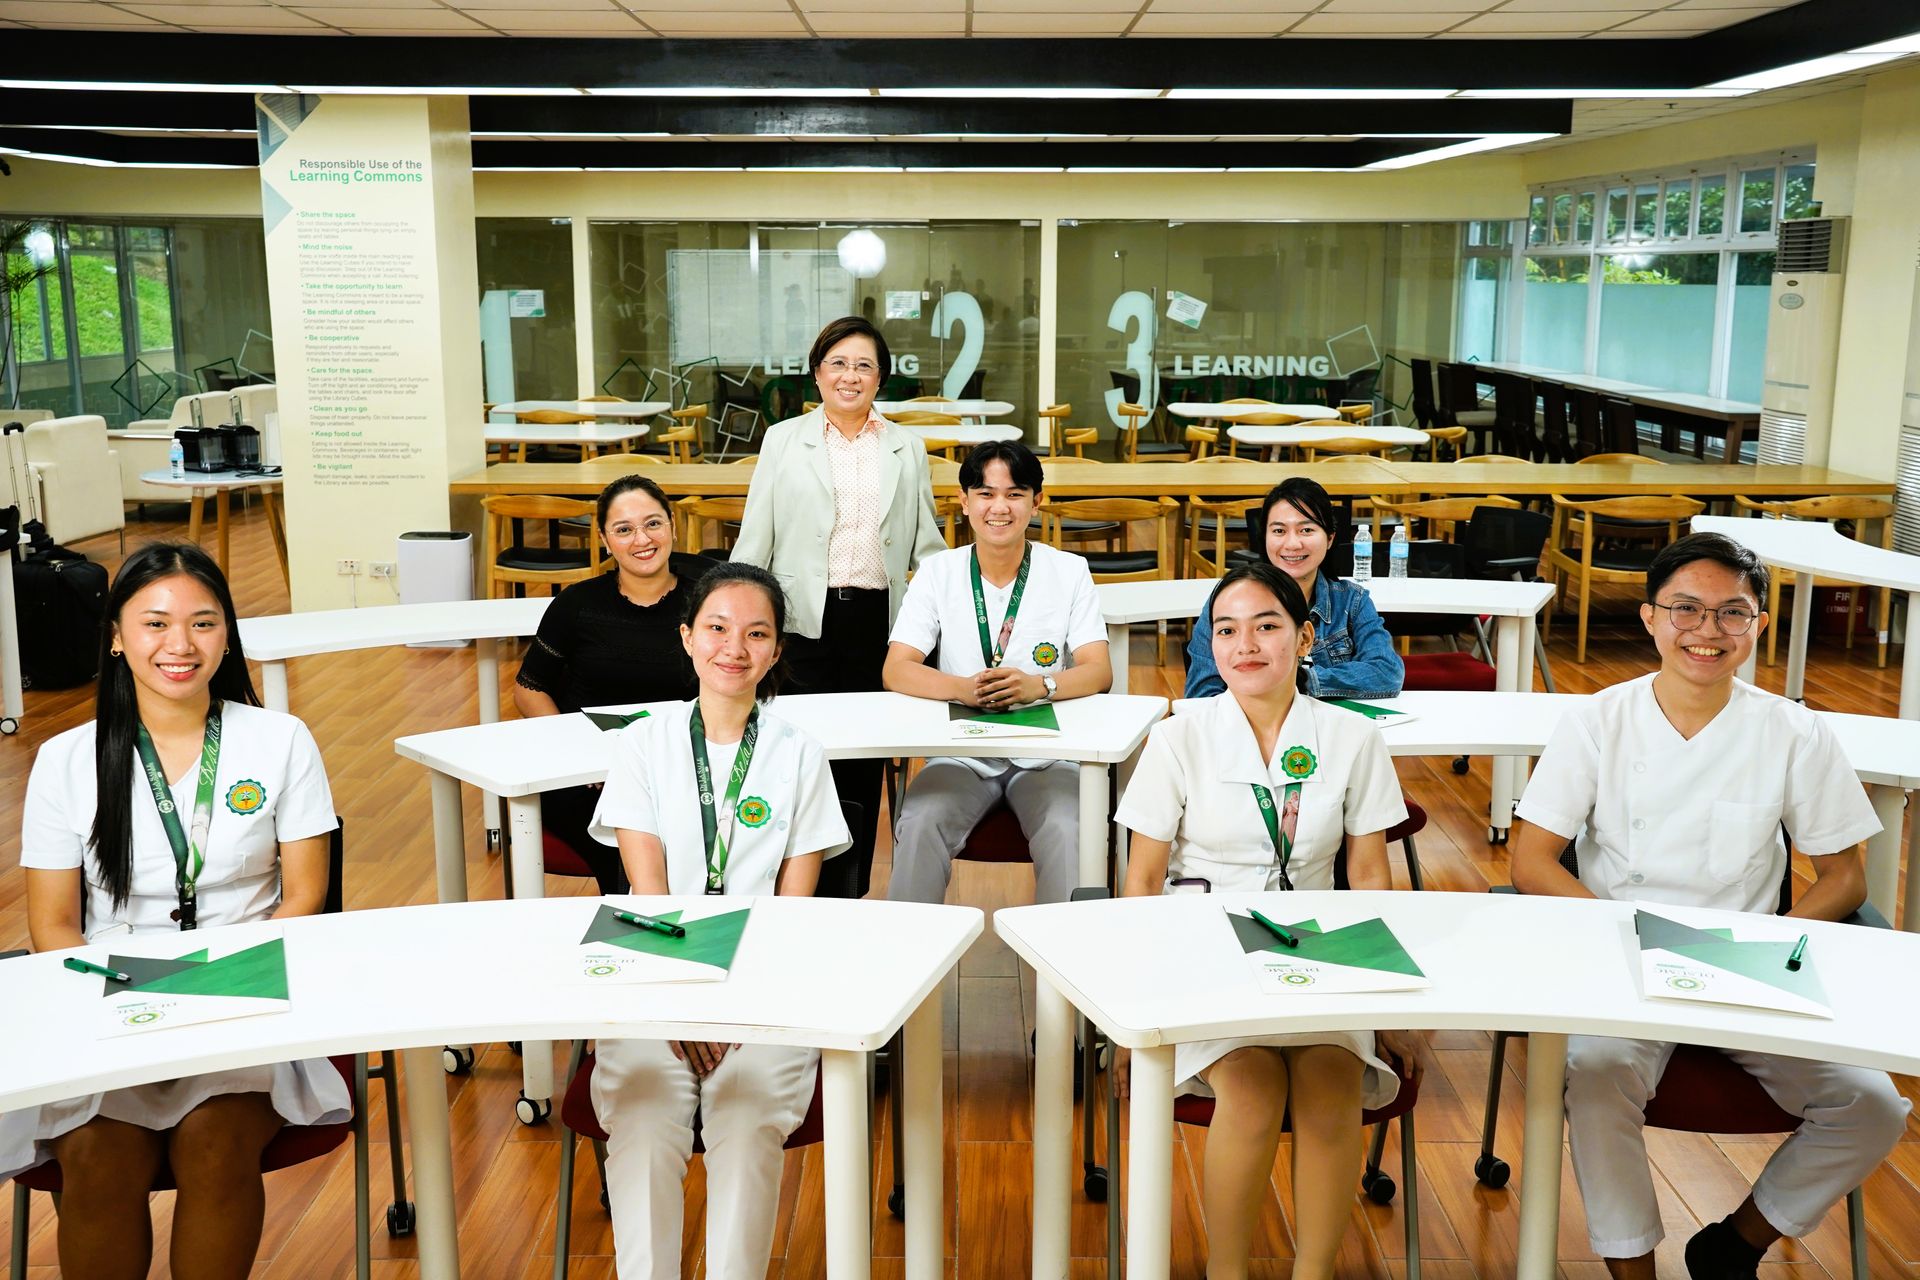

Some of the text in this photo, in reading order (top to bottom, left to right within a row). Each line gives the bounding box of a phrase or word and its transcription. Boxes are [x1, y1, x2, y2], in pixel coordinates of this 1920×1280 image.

[300, 159, 422, 170] Responsible Use of the
[290, 170, 423, 184] Learning Commons
[931, 291, 985, 425] 2
[1105, 291, 1160, 430] 3
[1174, 355, 1330, 377] LEARNING
[328, 463, 353, 471] vigilant
[1835, 591, 1851, 601] FIR
